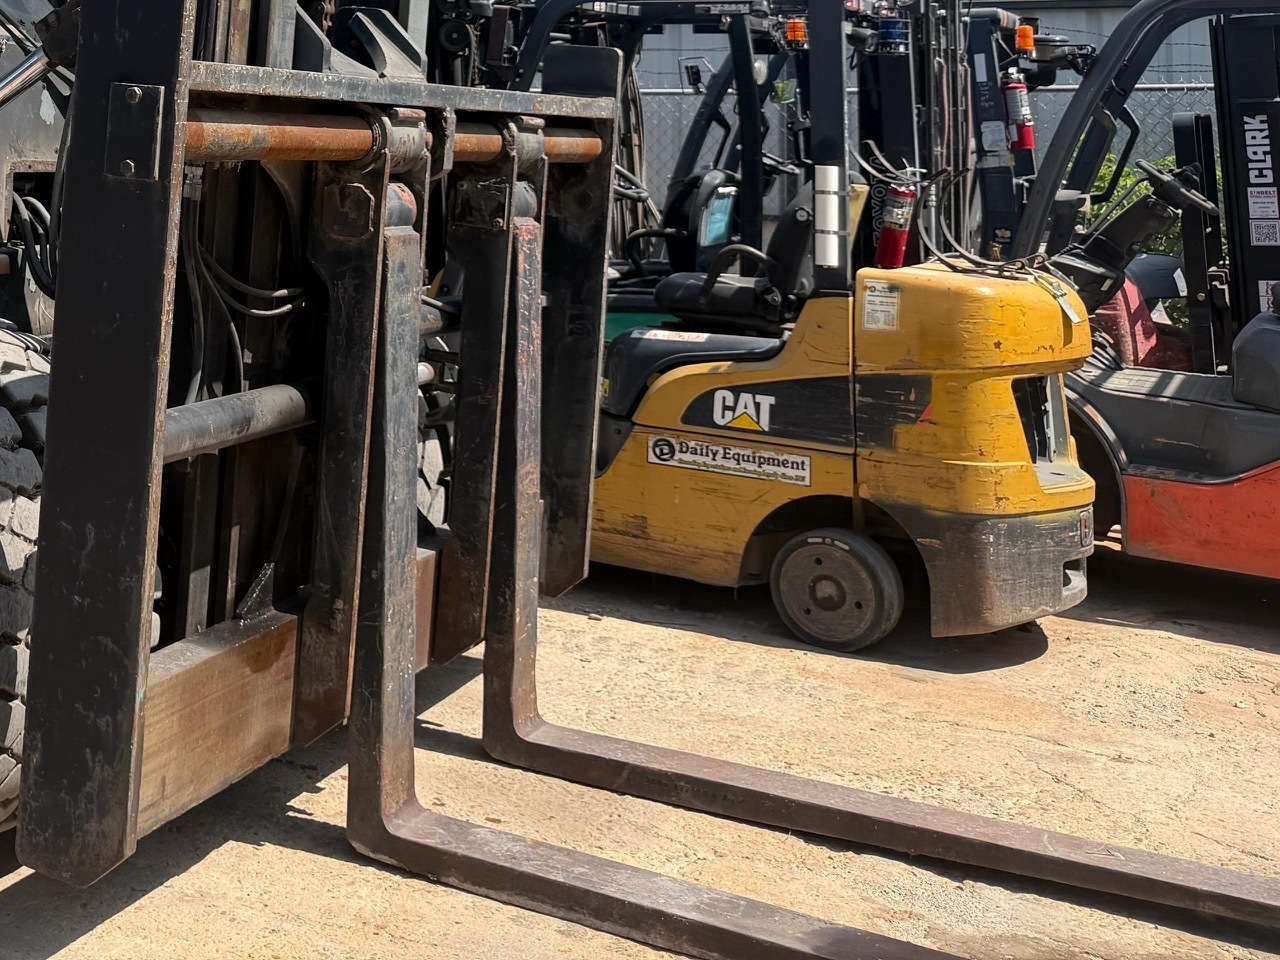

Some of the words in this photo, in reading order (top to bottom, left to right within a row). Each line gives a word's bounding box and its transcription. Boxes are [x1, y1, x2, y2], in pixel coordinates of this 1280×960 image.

[1243, 114, 1274, 184] CLARK
[713, 390, 775, 431] CAT
[678, 441, 719, 461] Daily
[721, 446, 807, 469] Equipment
